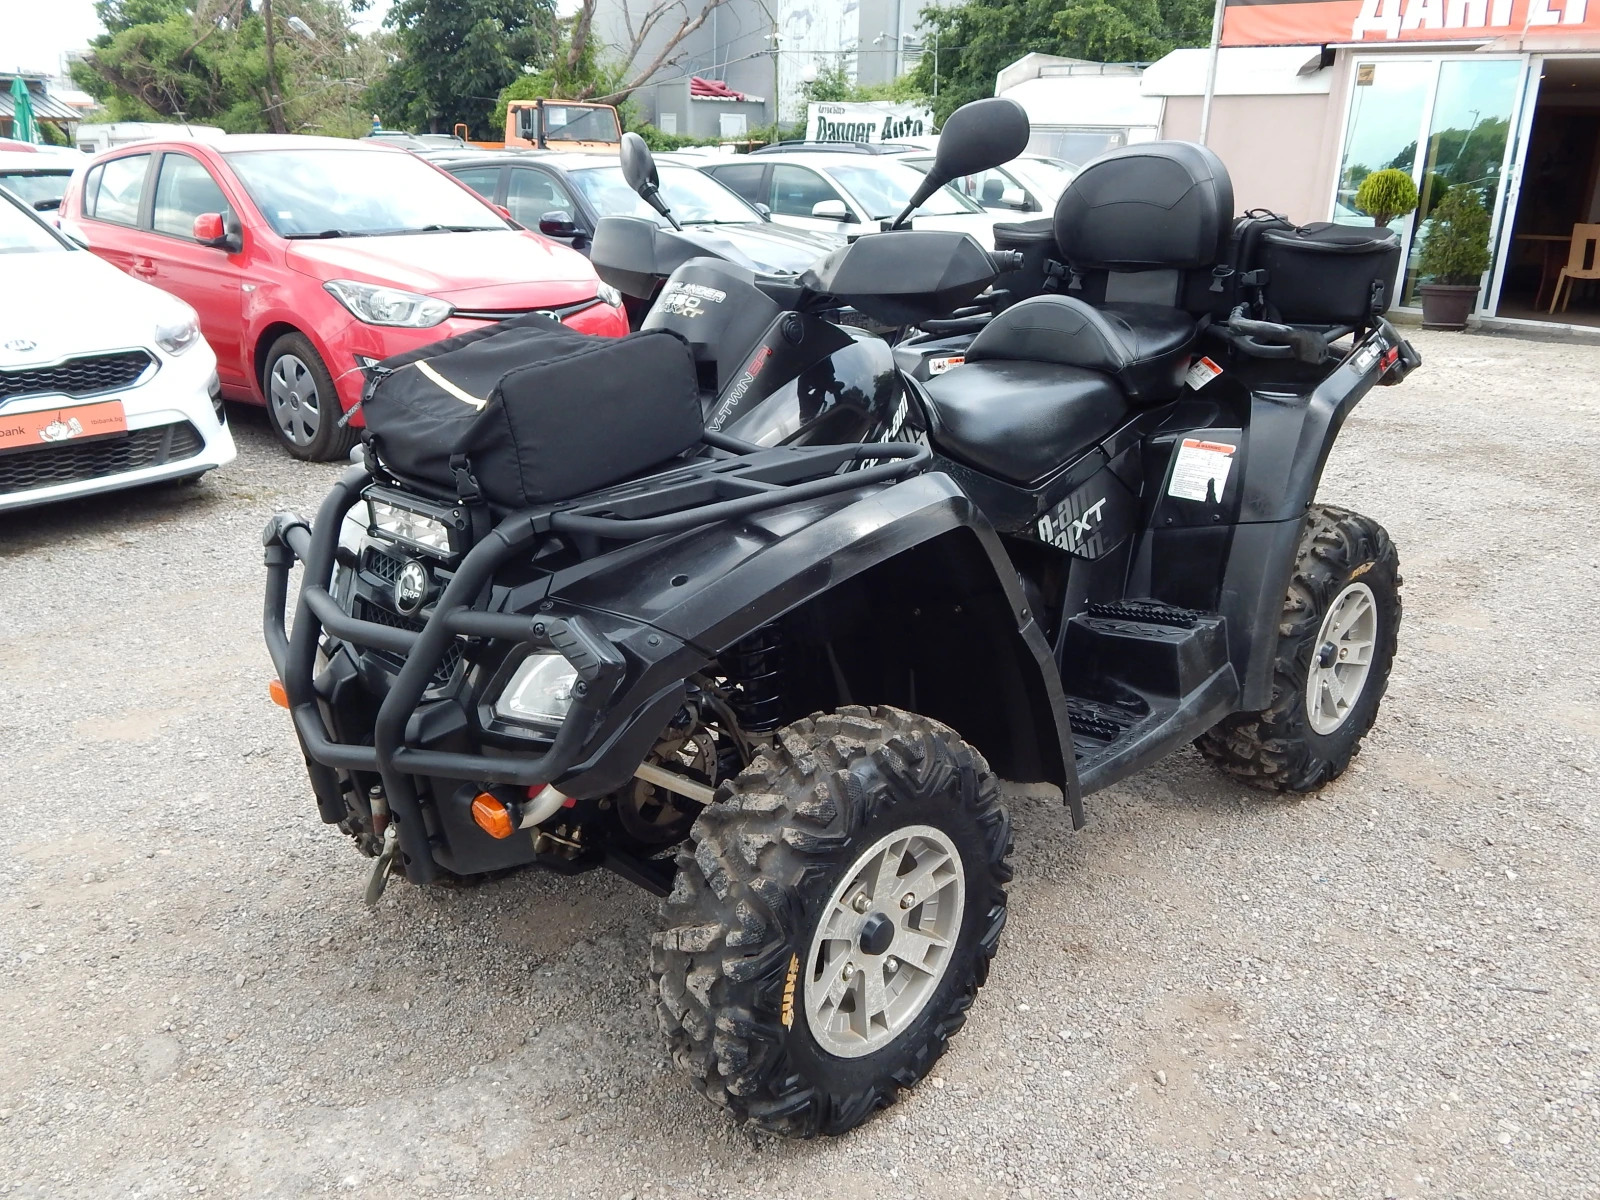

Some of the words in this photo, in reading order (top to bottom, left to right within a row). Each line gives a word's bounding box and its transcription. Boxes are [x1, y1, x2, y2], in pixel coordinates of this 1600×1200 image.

[881, 115, 924, 140] Auto
[1072, 497, 1107, 541] XT
[402, 588, 420, 599] BRP
